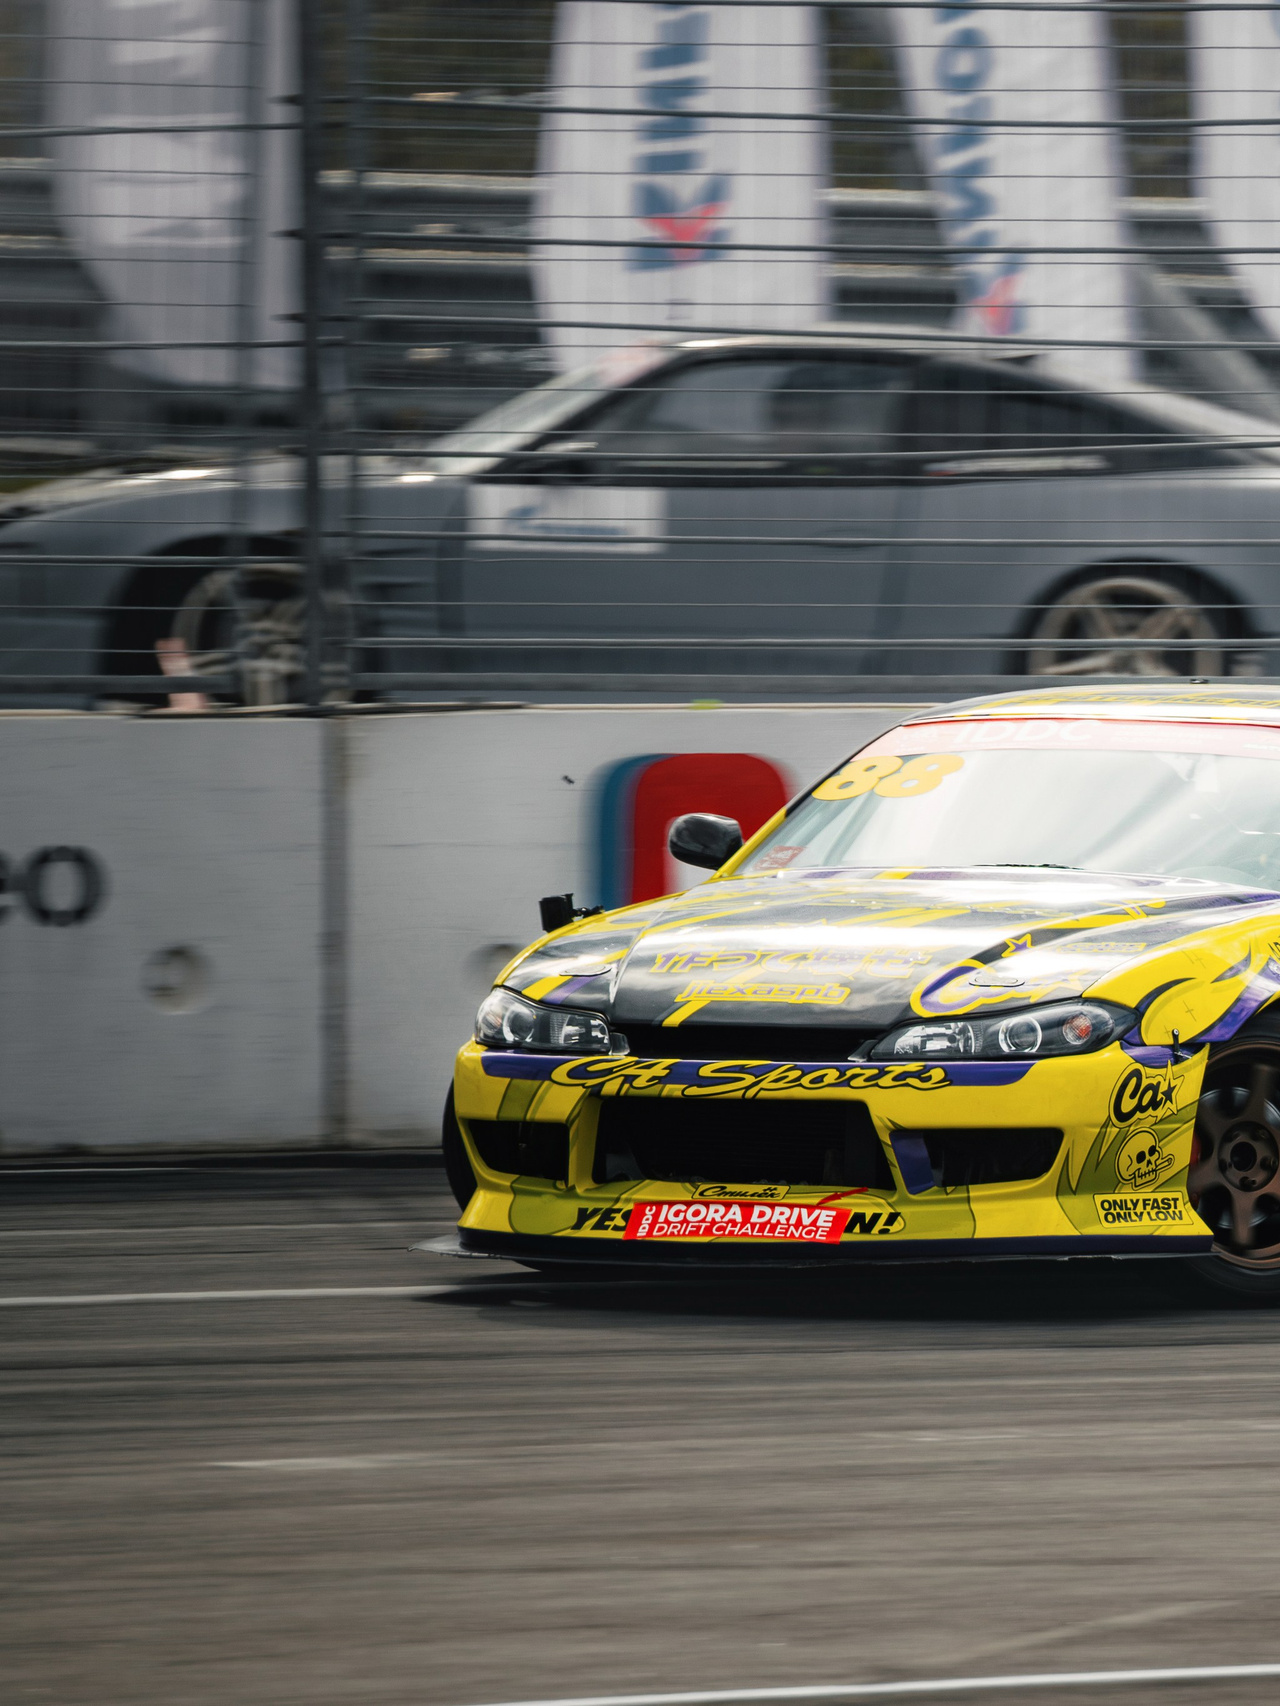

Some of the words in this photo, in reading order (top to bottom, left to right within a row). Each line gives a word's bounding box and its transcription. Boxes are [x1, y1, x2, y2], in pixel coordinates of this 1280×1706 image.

[953, 719, 1102, 744] IDDC
[811, 754, 965, 801] 88
[683, 1059, 952, 1099] Sports
[1113, 1068, 1163, 1123] Ca
[658, 1203, 743, 1223] IGORA
[750, 1205, 837, 1228] DRIVE
[1100, 1198, 1142, 1211] ONLY
[1142, 1198, 1180, 1211] FAST
[1103, 1211, 1144, 1224] ONLY
[1149, 1210, 1183, 1222] LOW
[637, 1205, 656, 1237] IDDC
[652, 1222, 710, 1236] DRIFT
[712, 1223, 830, 1240] CHALLENGE
